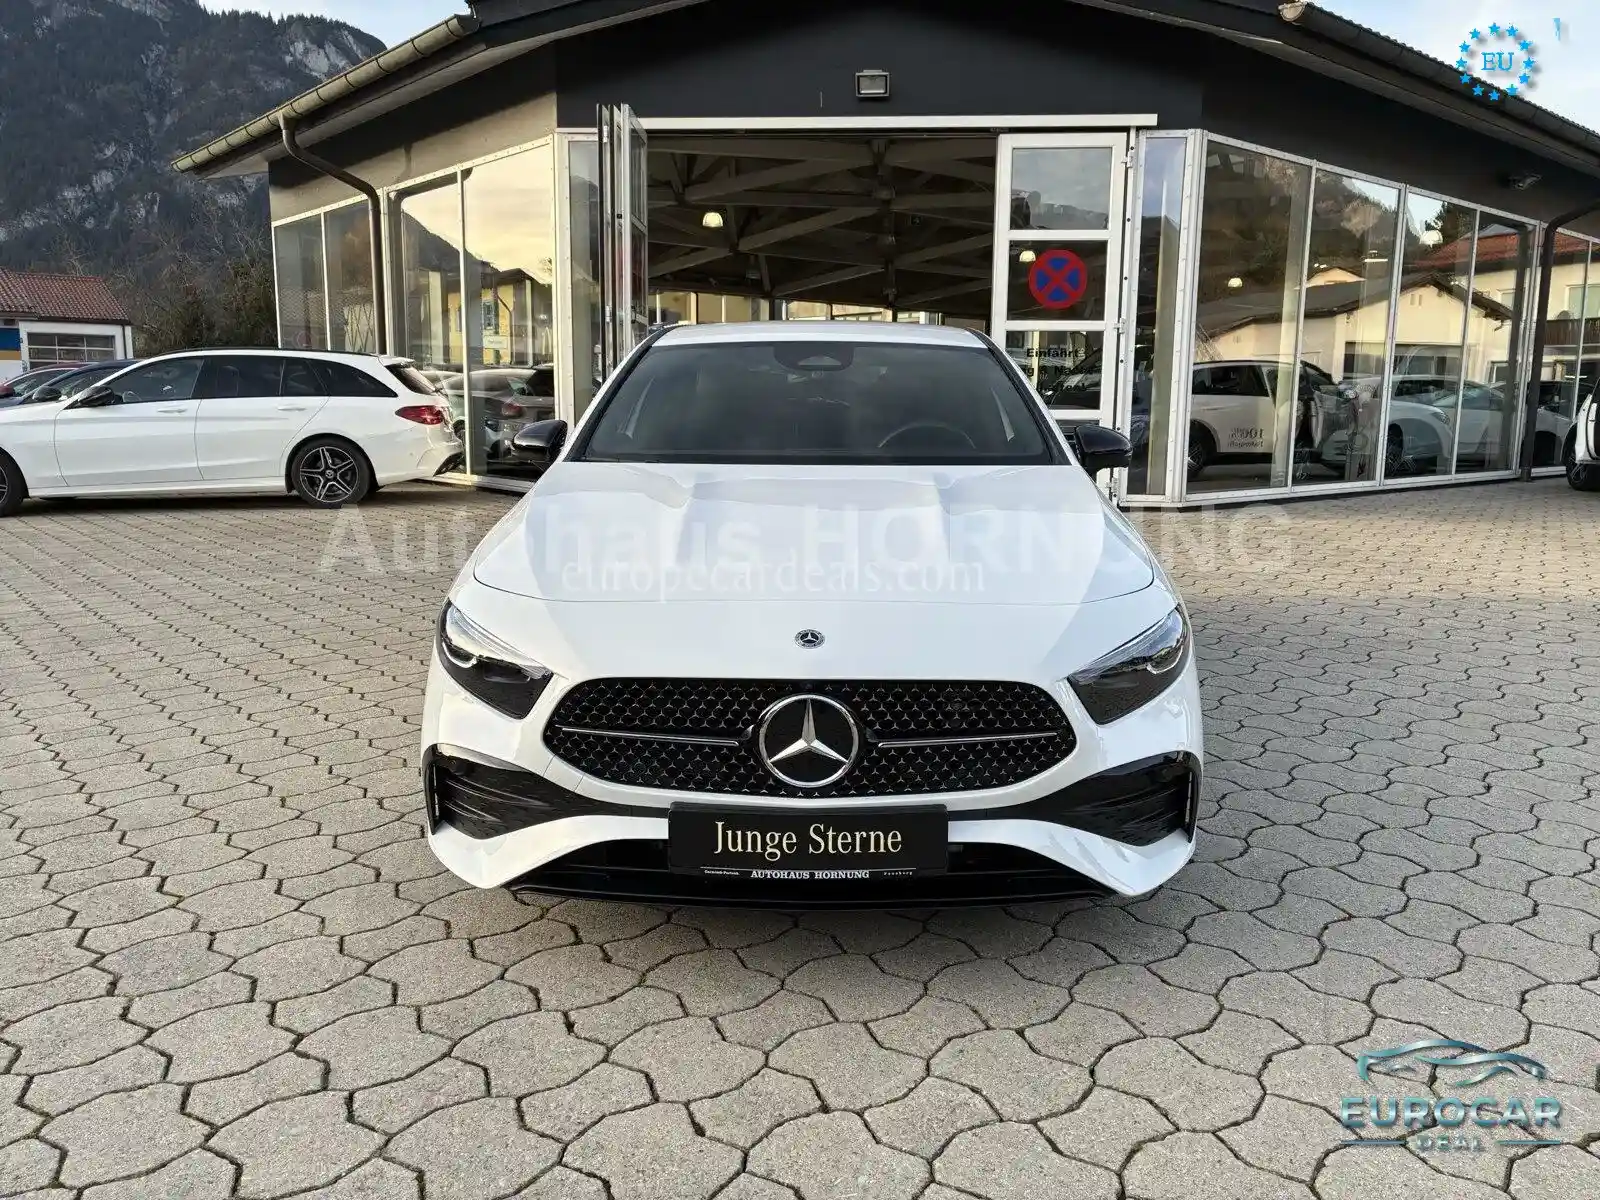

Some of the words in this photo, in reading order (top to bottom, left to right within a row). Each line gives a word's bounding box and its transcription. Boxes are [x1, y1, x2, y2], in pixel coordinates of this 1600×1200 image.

[714, 821, 797, 861] Junge
[808, 823, 902, 854] Sterne
[750, 870, 810, 879] AUTOHAUS
[814, 870, 870, 879] HORNUNG
